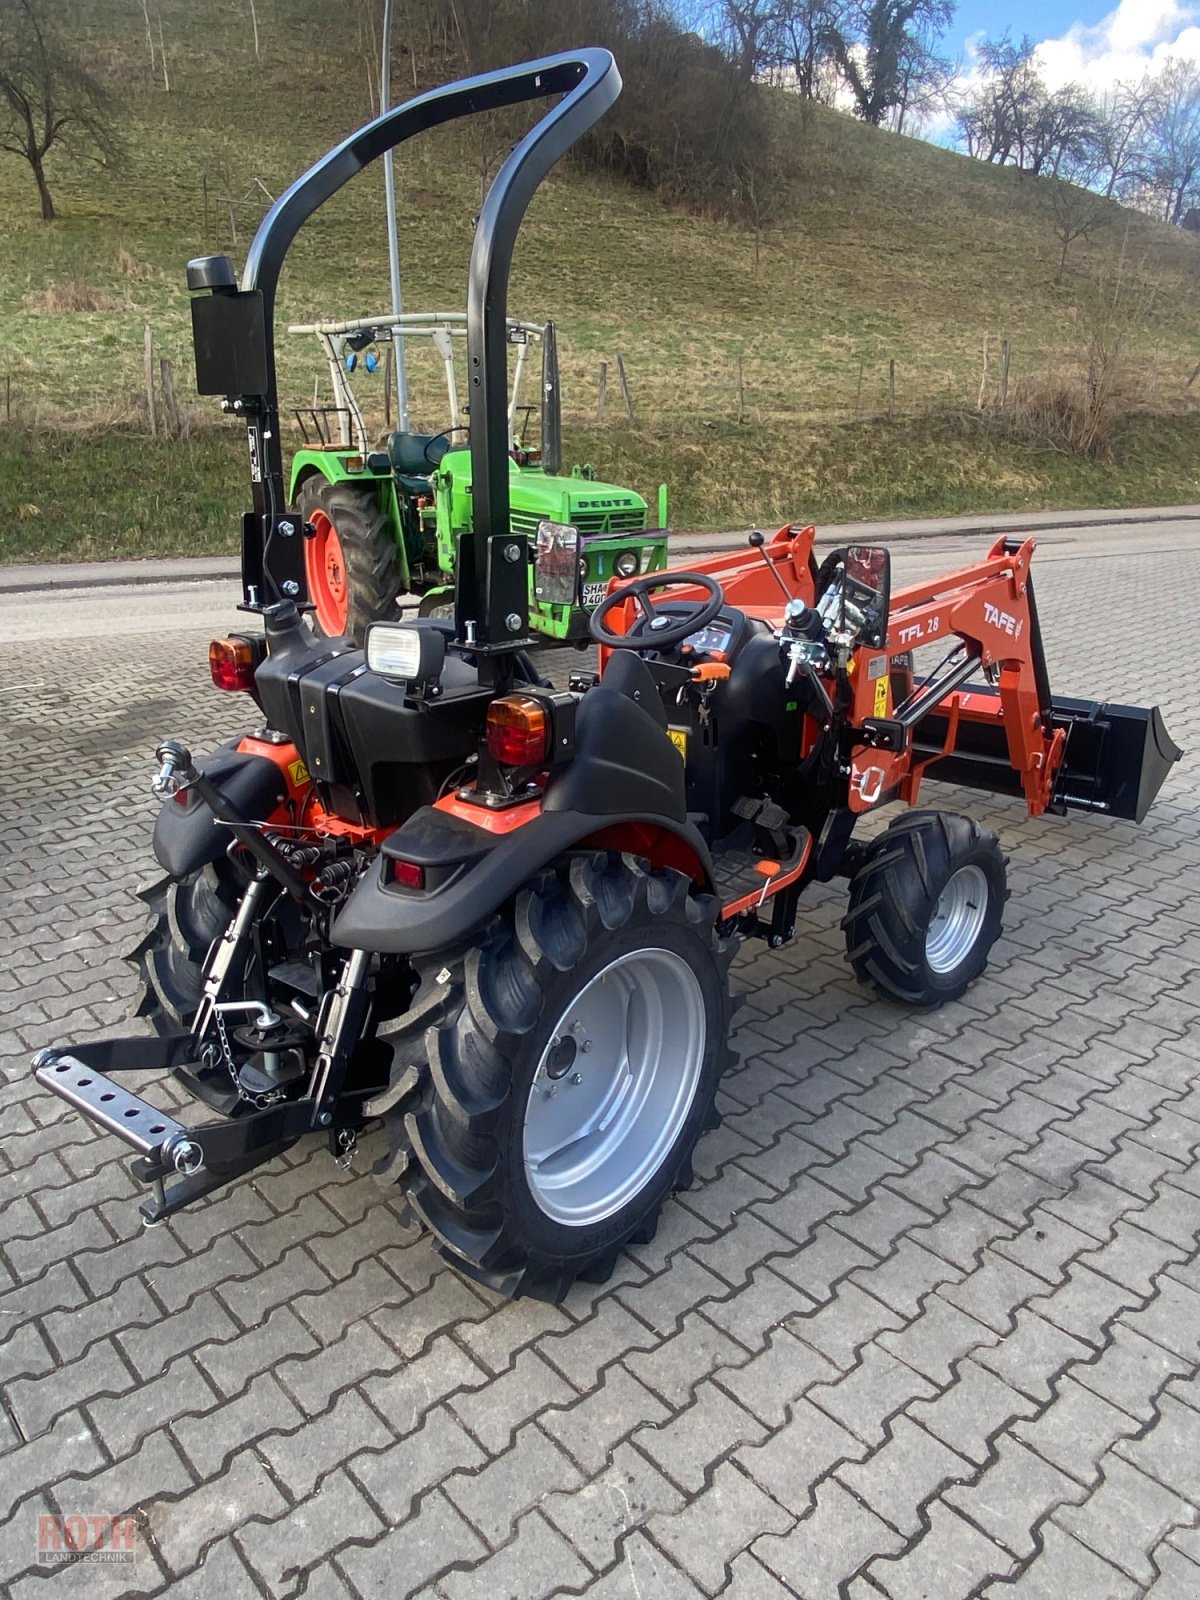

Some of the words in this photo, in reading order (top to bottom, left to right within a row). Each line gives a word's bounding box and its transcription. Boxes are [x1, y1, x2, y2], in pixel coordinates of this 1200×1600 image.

[577, 499, 633, 508] DEUTZ
[584, 584, 603, 595] SHA
[983, 602, 1016, 637] TAFE
[898, 623, 925, 644] TFL
[927, 616, 939, 634] 28
